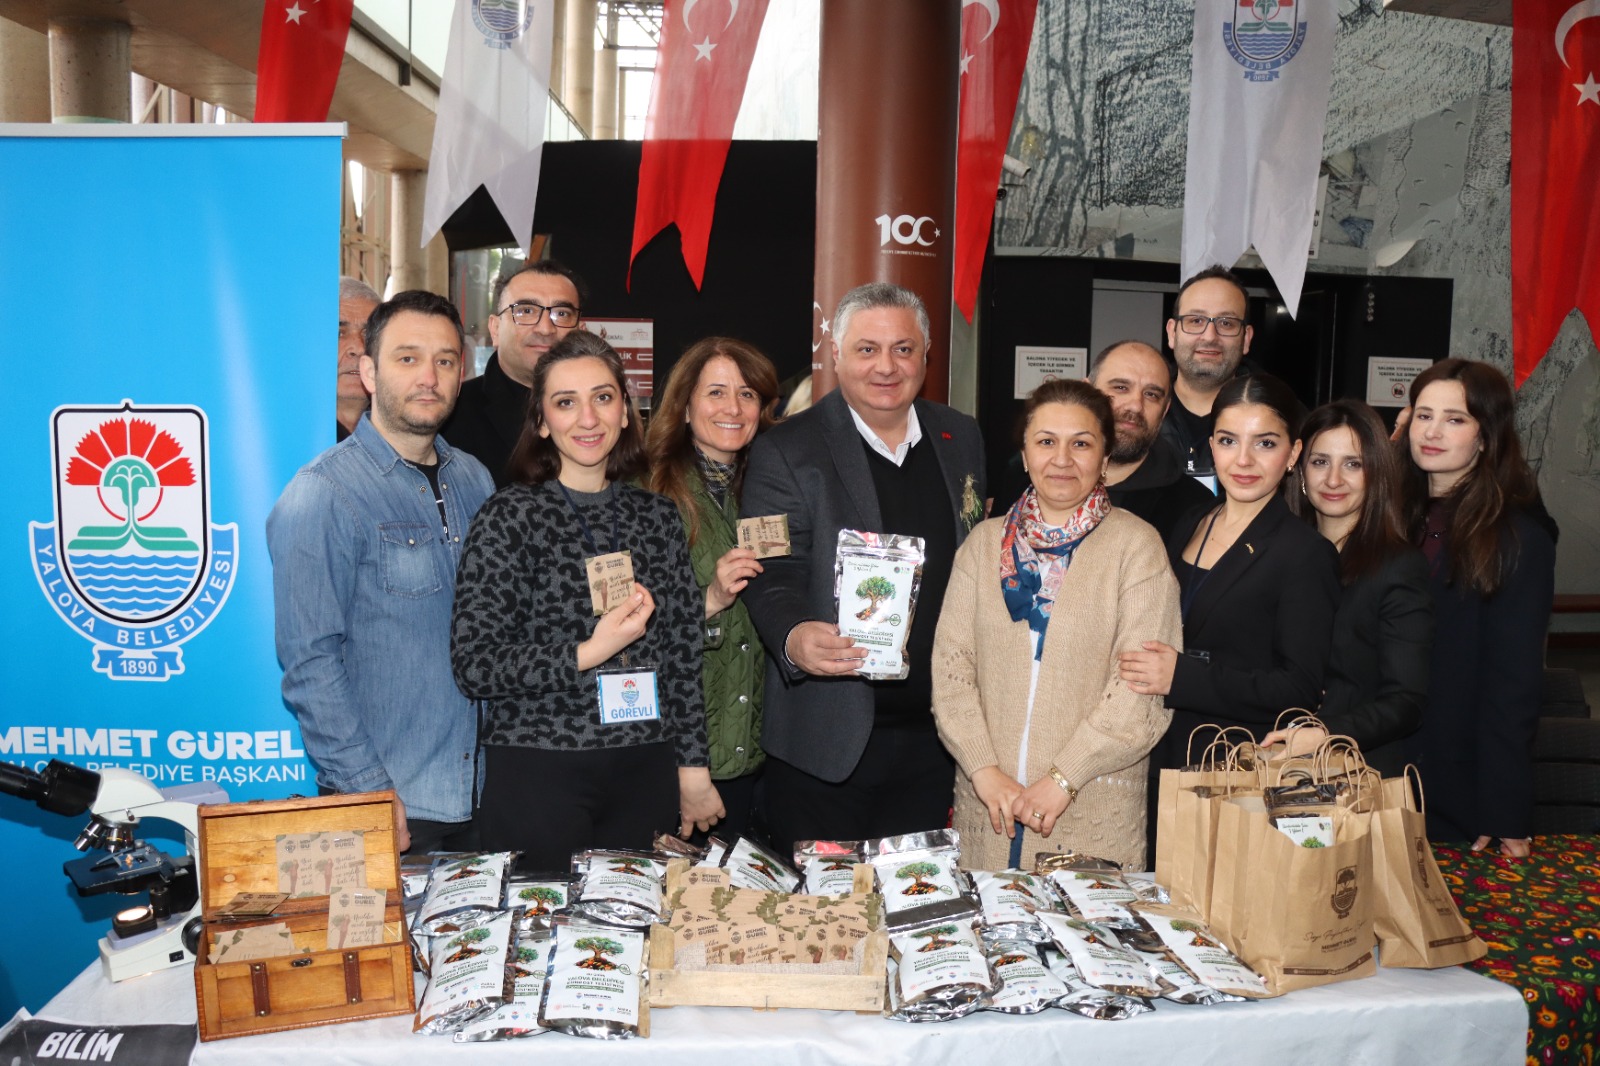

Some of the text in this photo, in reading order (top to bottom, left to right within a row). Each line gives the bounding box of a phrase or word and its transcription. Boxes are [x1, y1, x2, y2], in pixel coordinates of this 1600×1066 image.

[38, 543, 232, 646] YALOVA BELEDİYESİ
[120, 660, 157, 674] 1890
[611, 704, 653, 720] GÖREVLİ
[0, 726, 158, 757] MEHMET
[202, 764, 306, 787] BAŞKANI
[37, 1028, 124, 1062] BİLİM
